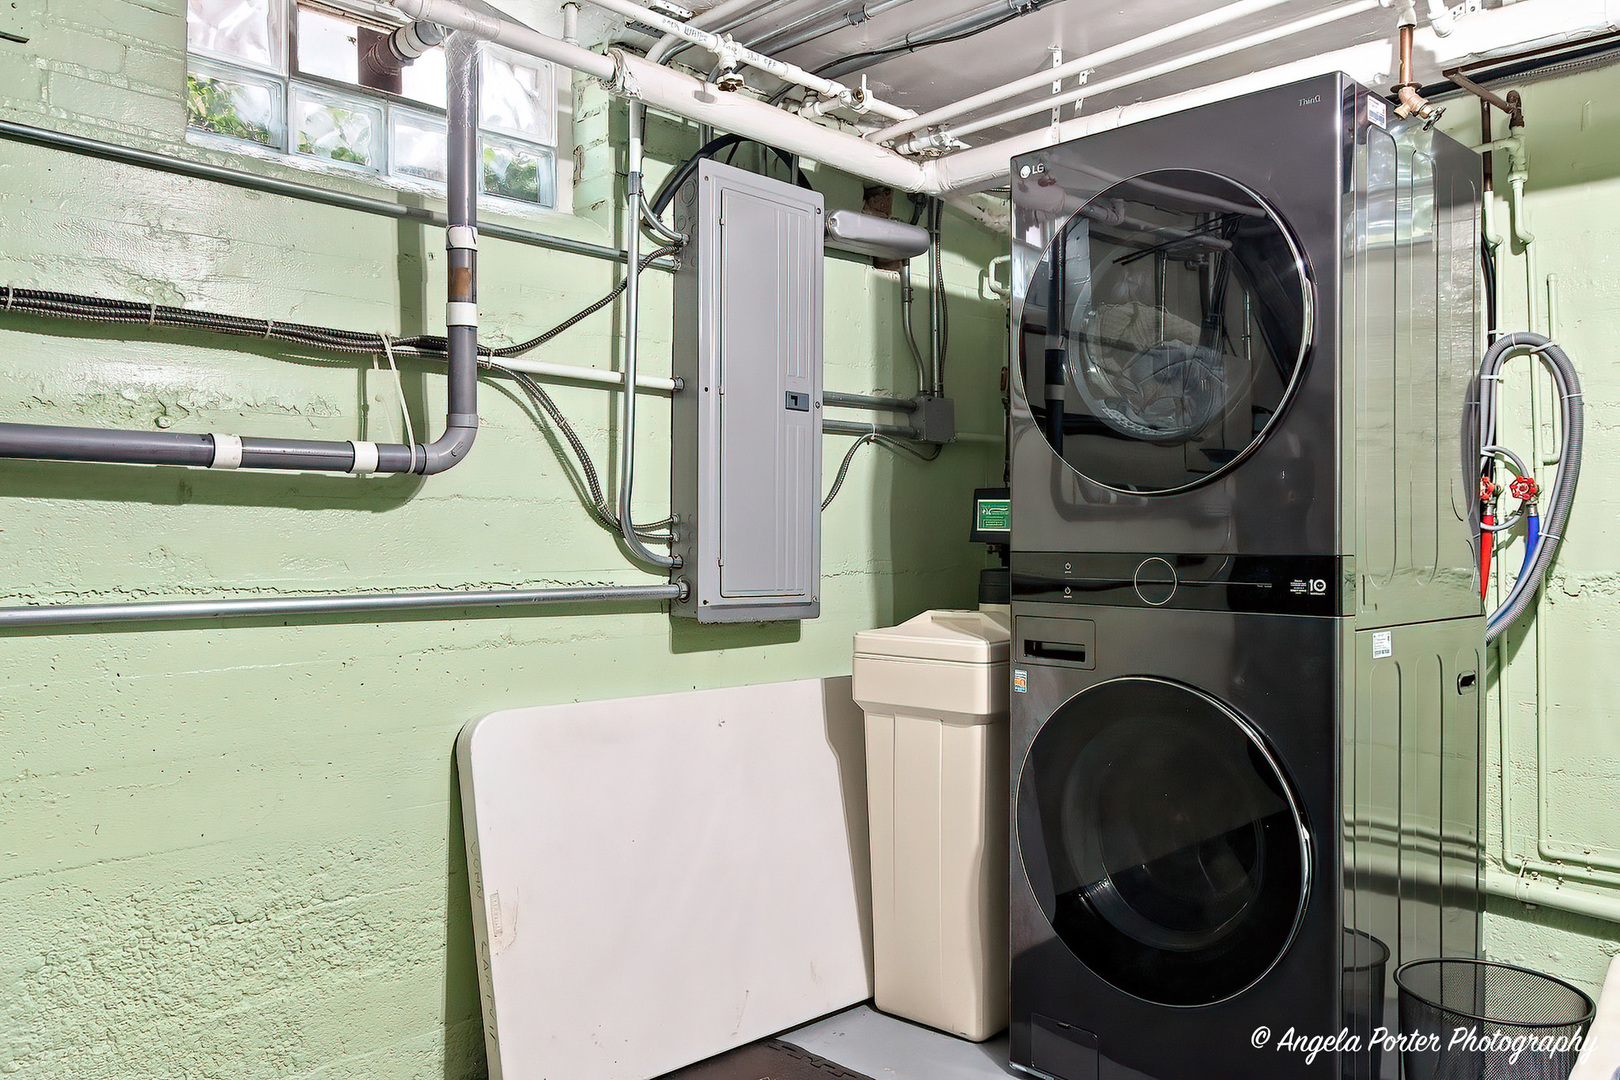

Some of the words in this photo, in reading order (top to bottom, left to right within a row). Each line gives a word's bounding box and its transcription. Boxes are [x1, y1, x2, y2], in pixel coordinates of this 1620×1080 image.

[1298, 94, 1321, 106] ThinQ
[1032, 163, 1044, 175] LG
[1309, 578, 1327, 593] 10
